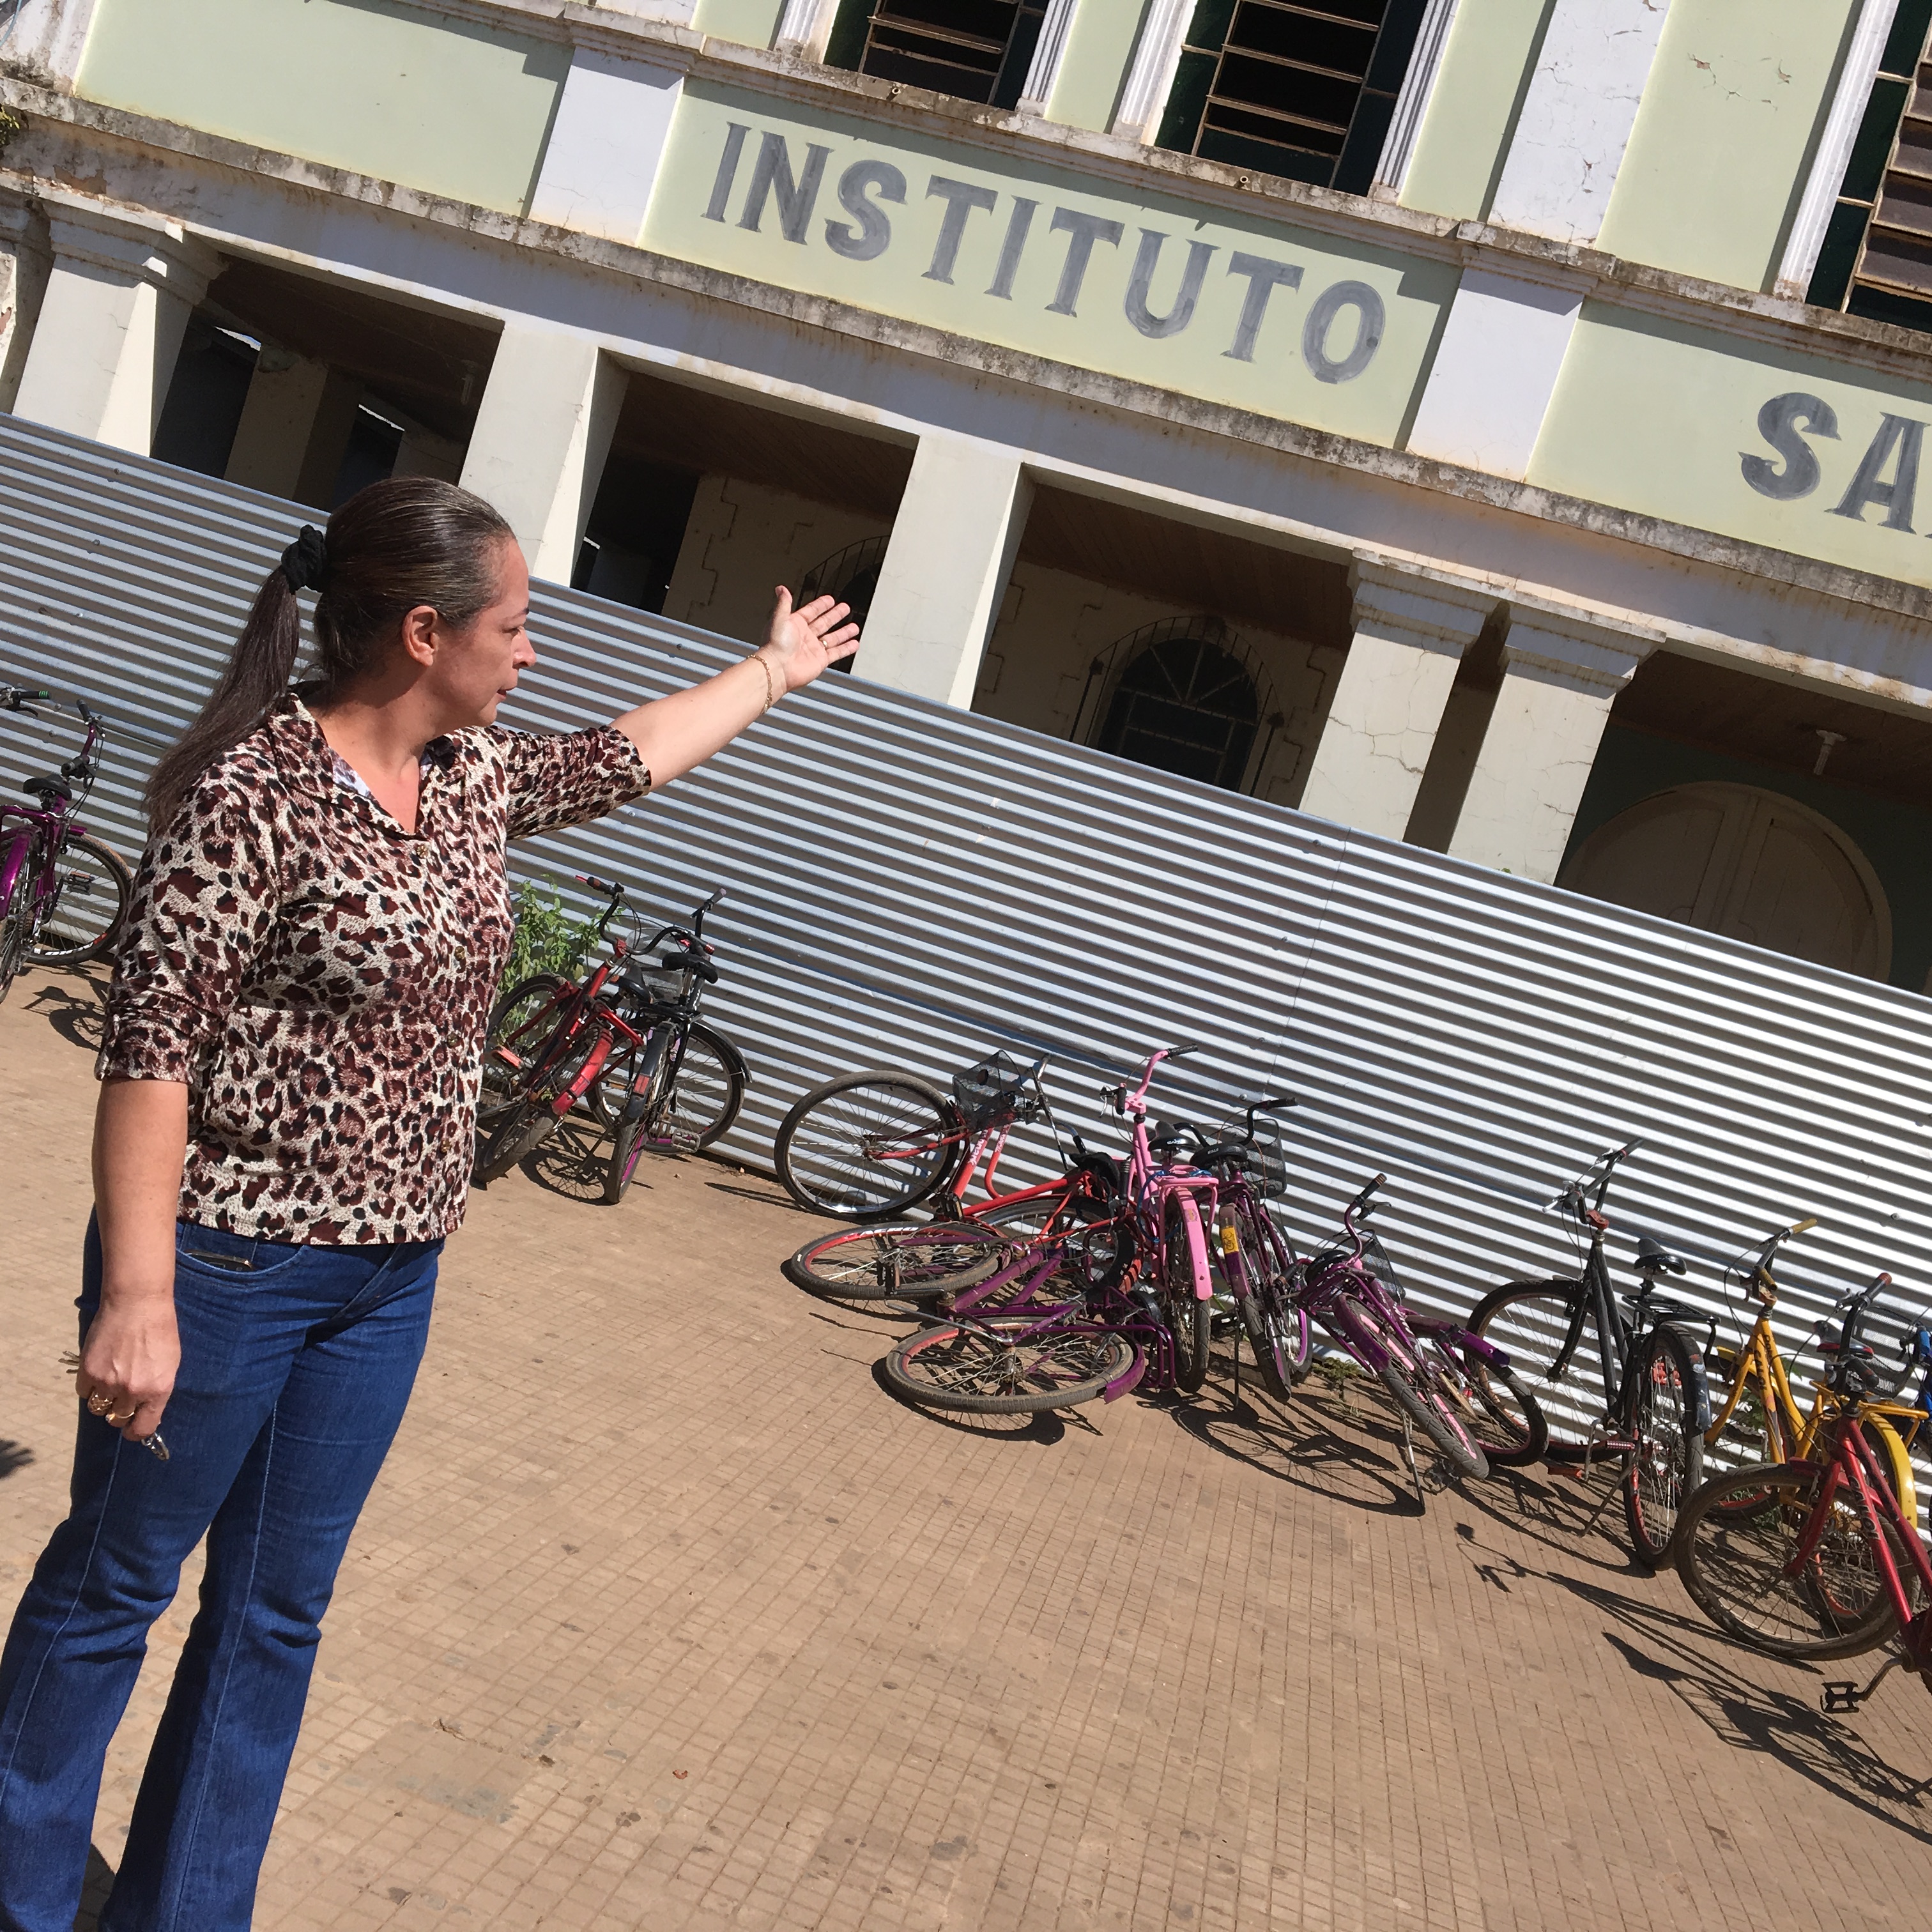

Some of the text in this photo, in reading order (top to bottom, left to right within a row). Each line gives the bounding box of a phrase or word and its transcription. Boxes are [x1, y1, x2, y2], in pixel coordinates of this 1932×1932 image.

[700, 121, 1386, 385] INSTITUTO
[1737, 392, 1932, 539] SA
[1847, 1475, 1881, 1542] CALOI
